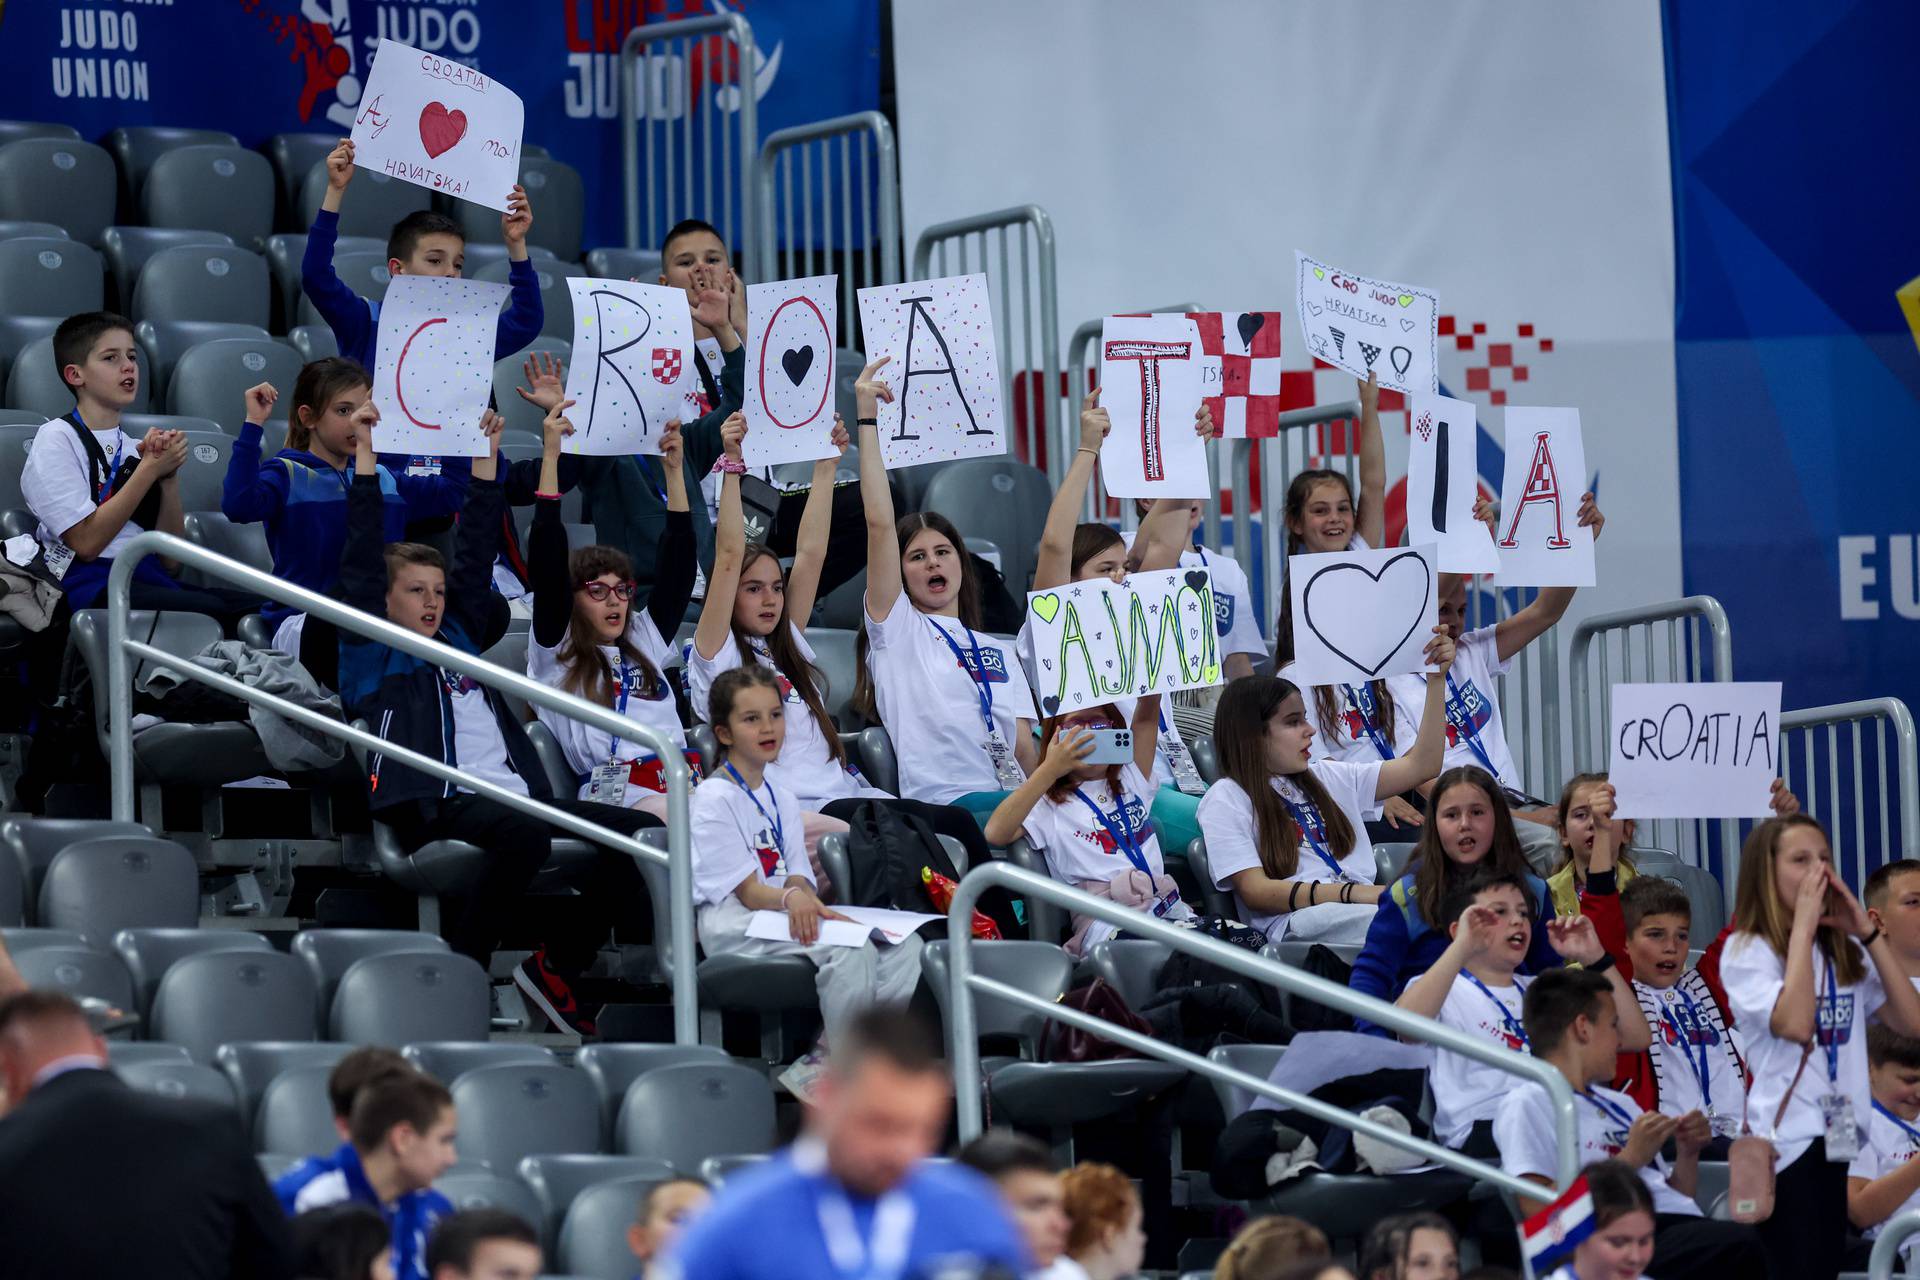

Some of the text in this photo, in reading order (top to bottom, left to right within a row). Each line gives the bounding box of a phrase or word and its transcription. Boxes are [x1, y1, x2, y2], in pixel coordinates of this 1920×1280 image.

[60, 9, 138, 52] JUDO
[364, 5, 480, 54] JUDO
[52, 57, 149, 102] UNION
[421, 55, 491, 90] CROATIA!
[385, 158, 470, 197] HRVATSKA!
[1324, 296, 1388, 324] HRVATSKA
[1331, 275, 1397, 306] CRO JUDO
[1620, 703, 1772, 770] CROATIA
